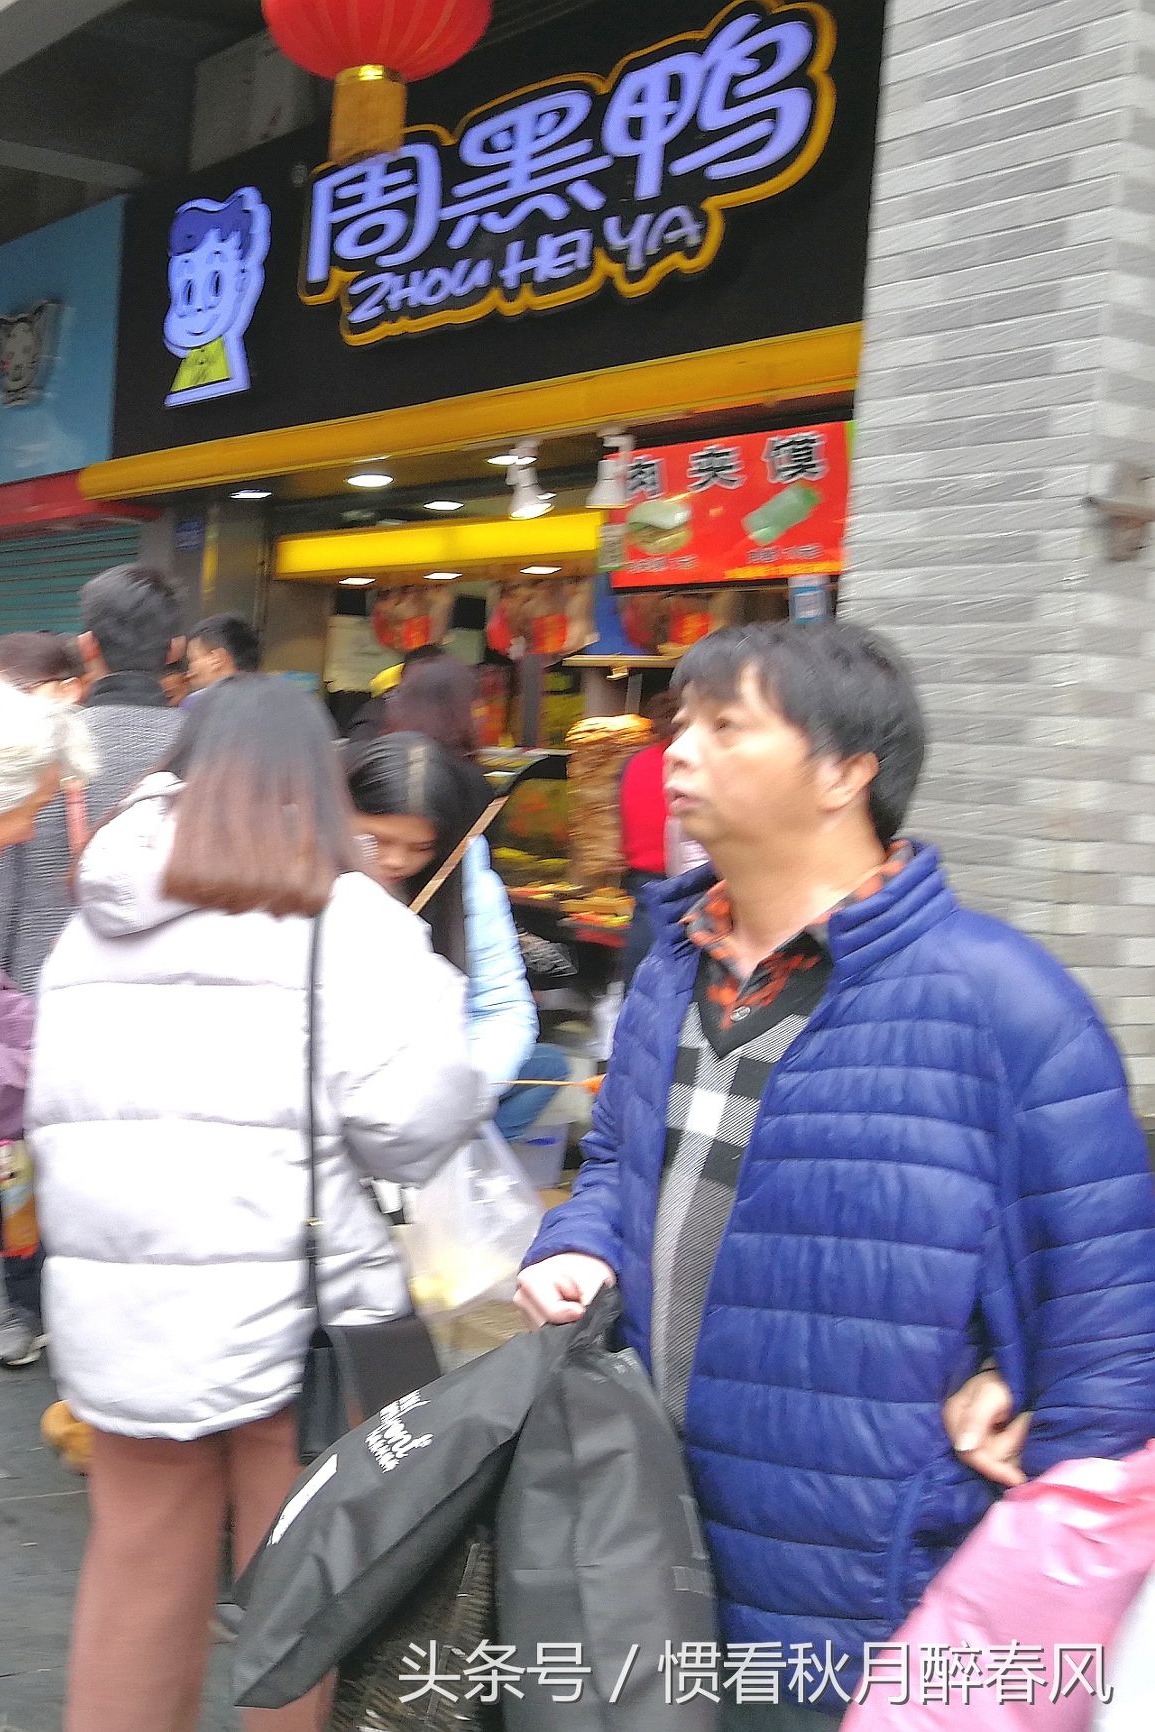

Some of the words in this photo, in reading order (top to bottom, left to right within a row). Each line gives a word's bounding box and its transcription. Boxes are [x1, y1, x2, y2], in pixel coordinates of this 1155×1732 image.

[306, 12, 814, 283] 周黑鸭
[347, 257, 492, 324] ZHOU
[498, 228, 594, 289] HEI
[603, 204, 705, 271] YA
